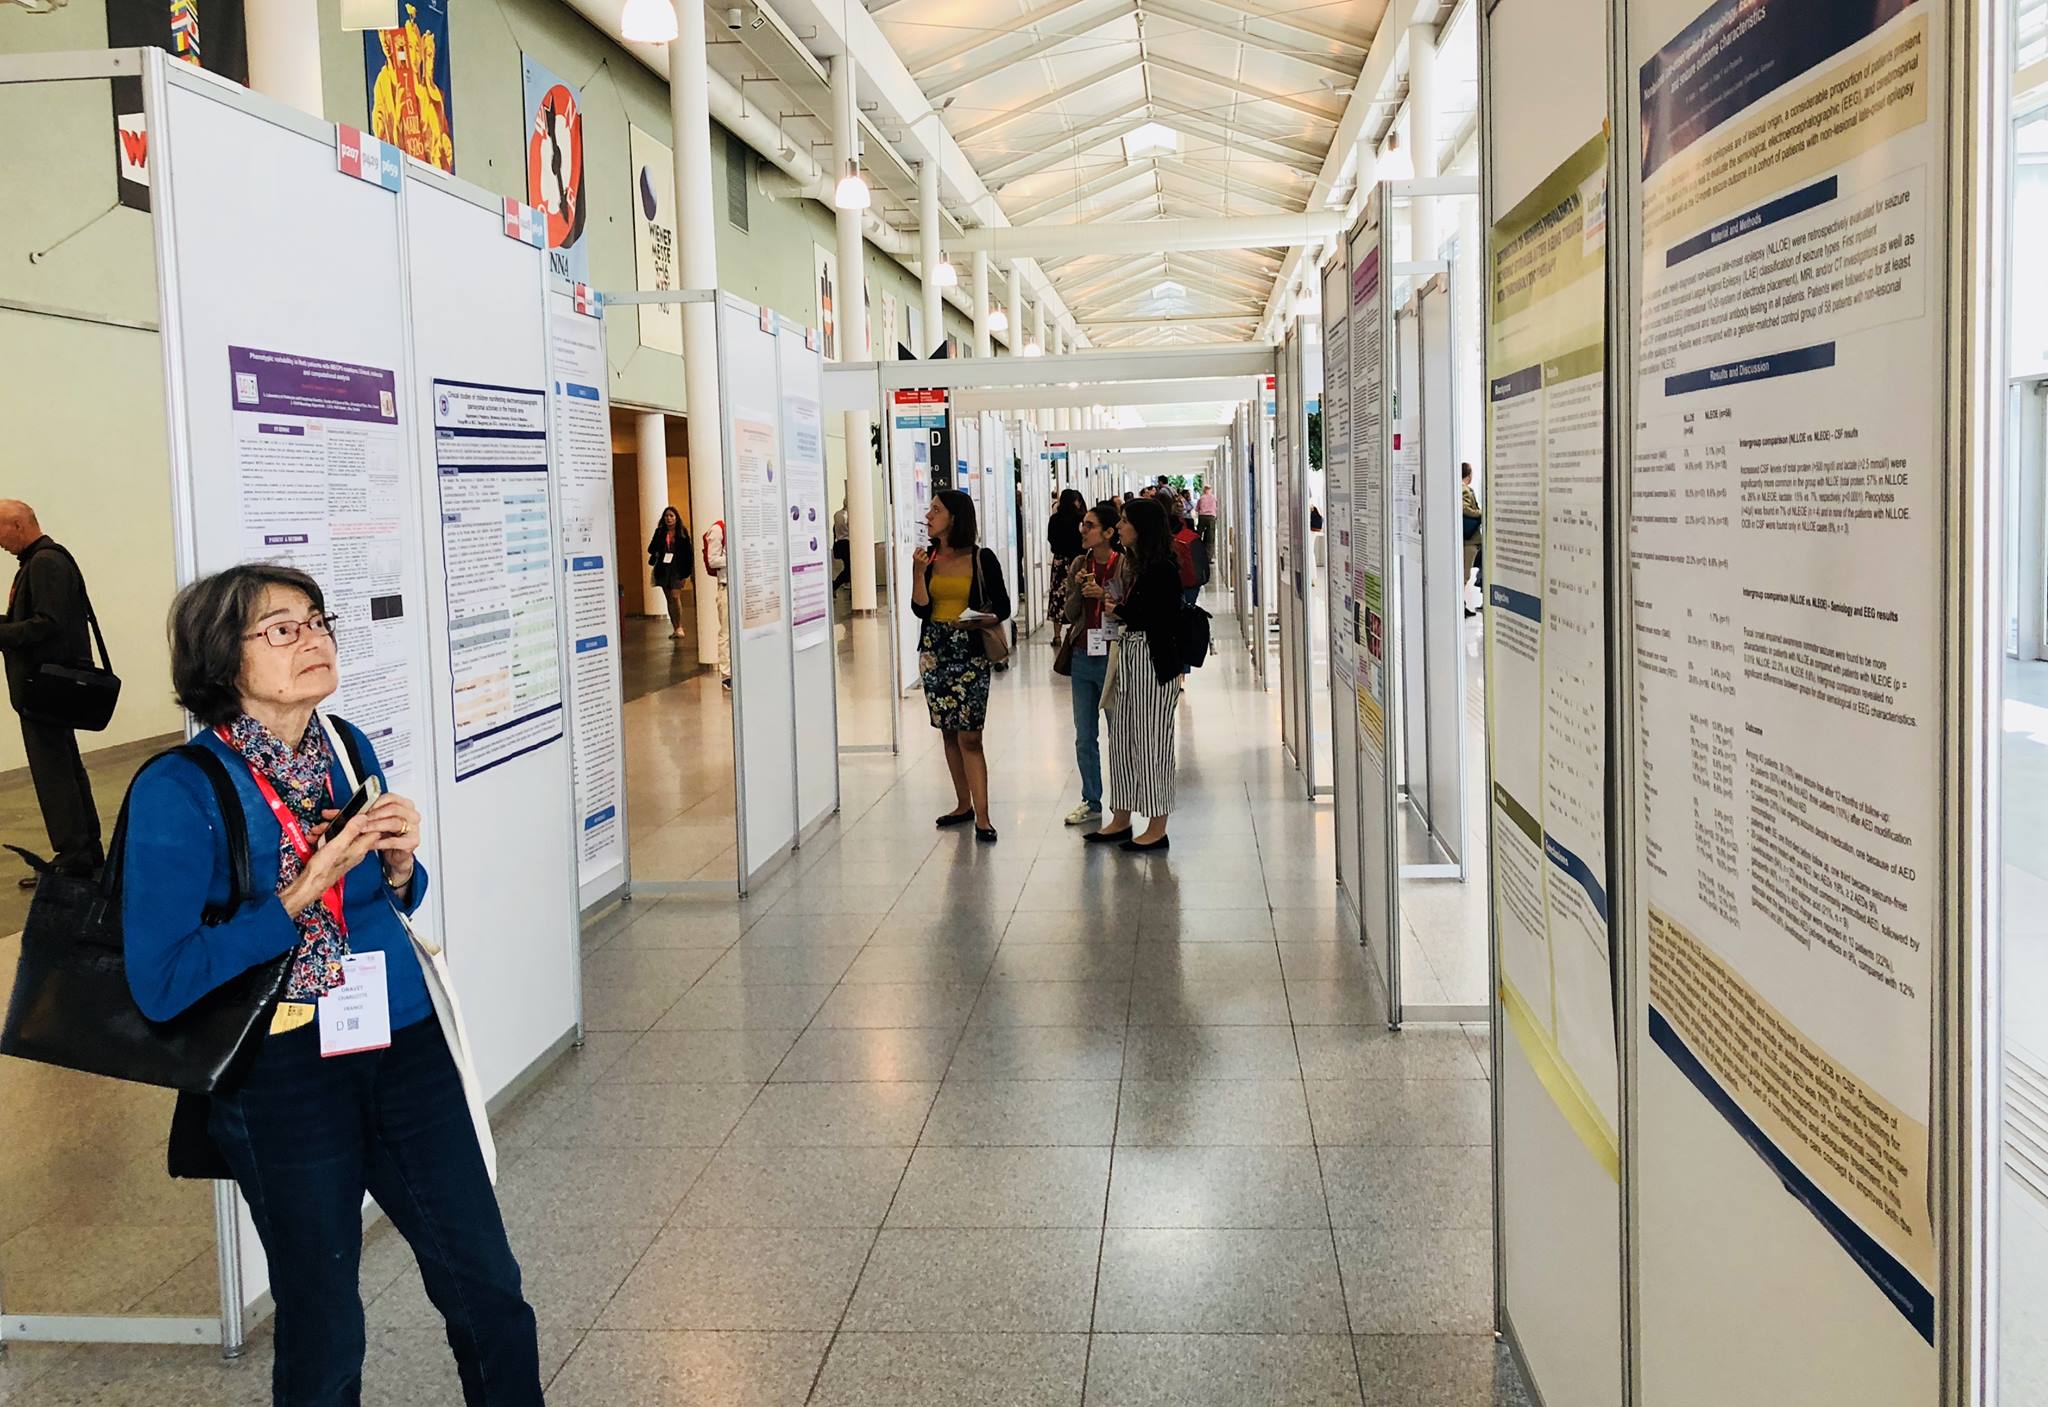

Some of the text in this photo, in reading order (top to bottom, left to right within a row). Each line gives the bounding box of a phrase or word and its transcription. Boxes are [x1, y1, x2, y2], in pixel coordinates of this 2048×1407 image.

[1696, 5, 1766, 71] outcome characteristics
[1748, 31, 1921, 140] lesional origin, a considerable proportion of patients present
[1767, 53, 1919, 148] electroencephalographic (EEG), and cerebrospinal
[1758, 80, 1915, 173] cohort of patients with non-lesional late-onset epilepsy
[341, 143, 359, 163] p207
[406, 137, 424, 156] 1926
[648, 221, 671, 246] WIENER
[1710, 211, 1762, 243] Material and Methods
[1744, 190, 1911, 265] epilepsy (NLLOE) were retrospectively evaluated for seizure
[550, 251, 569, 277] NNA
[652, 243, 671, 264] MESSE
[1759, 223, 1878, 278] classification of seizure types. First inpatient
[1742, 232, 1915, 300] electrode placement), MRI, and/or CT investigations as well as
[1749, 299, 1768, 315] testing
[1782, 288, 1805, 307] patients.
[1807, 281, 1830, 300] Patients
[1831, 278, 1844, 293] were
[1845, 266, 1874, 289] followed-up
[1874, 263, 1883, 277] for
[1884, 260, 1891, 274] at
[1892, 252, 1911, 273] least
[1723, 277, 1902, 339] with gender-matched control group of 58 patients with non-lesional
[1709, 360, 1770, 380] Results and Discussion
[931, 430, 942, 447] D
[1739, 437, 1762, 450] Intergroup
[1762, 434, 1788, 448] comparison
[1789, 431, 1806, 446] (NLLOE
[1813, 429, 1830, 443] NLEOE)
[1834, 428, 1843, 441] CSF
[1843, 426, 1858, 439] results
[1890, 458, 1907, 469] were
[1884, 473, 1908, 486] NLLOE
[1864, 490, 1895, 505] Pleocytosis
[1873, 507, 1911, 520] with NLLOE.
[1742, 587, 1764, 601] Intergroup
[1764, 591, 1789, 603] comparison
[1789, 593, 1806, 606] (NLLOE
[1812, 596, 1828, 610] NLEOE)
[1830, 600, 1853, 618] Semiology
[1853, 605, 1863, 617] and
[1864, 606, 1876, 619] EEG
[1876, 609, 1899, 623] results
[1835, 647, 1846, 659] were
[1846, 648, 1860, 662] found
[1864, 655, 1872, 666] be
[1872, 658, 1887, 671] more
[1860, 670, 1870, 684] with
[1870, 673, 1892, 689] NLEOE
[1893, 675, 1901, 692] (p
[1862, 687, 1894, 706] revealed no
[1858, 701, 1918, 728] EEG characteristics.
[1745, 721, 1763, 736] Outcome
[1841, 792, 1859, 811] months
[1851, 813, 1912, 847] after AED modification
[1856, 846, 1916, 882] one because of AED
[1851, 875, 1908, 912] became seizure-free
[1880, 922, 1920, 953] followed by
[1858, 959, 1915, 1000] compared with 12%
[1858, 1086, 1898, 1130] Presence of
[1820, 1127, 1848, 1165] adequate
[1891, 1132, 1901, 1152] for
